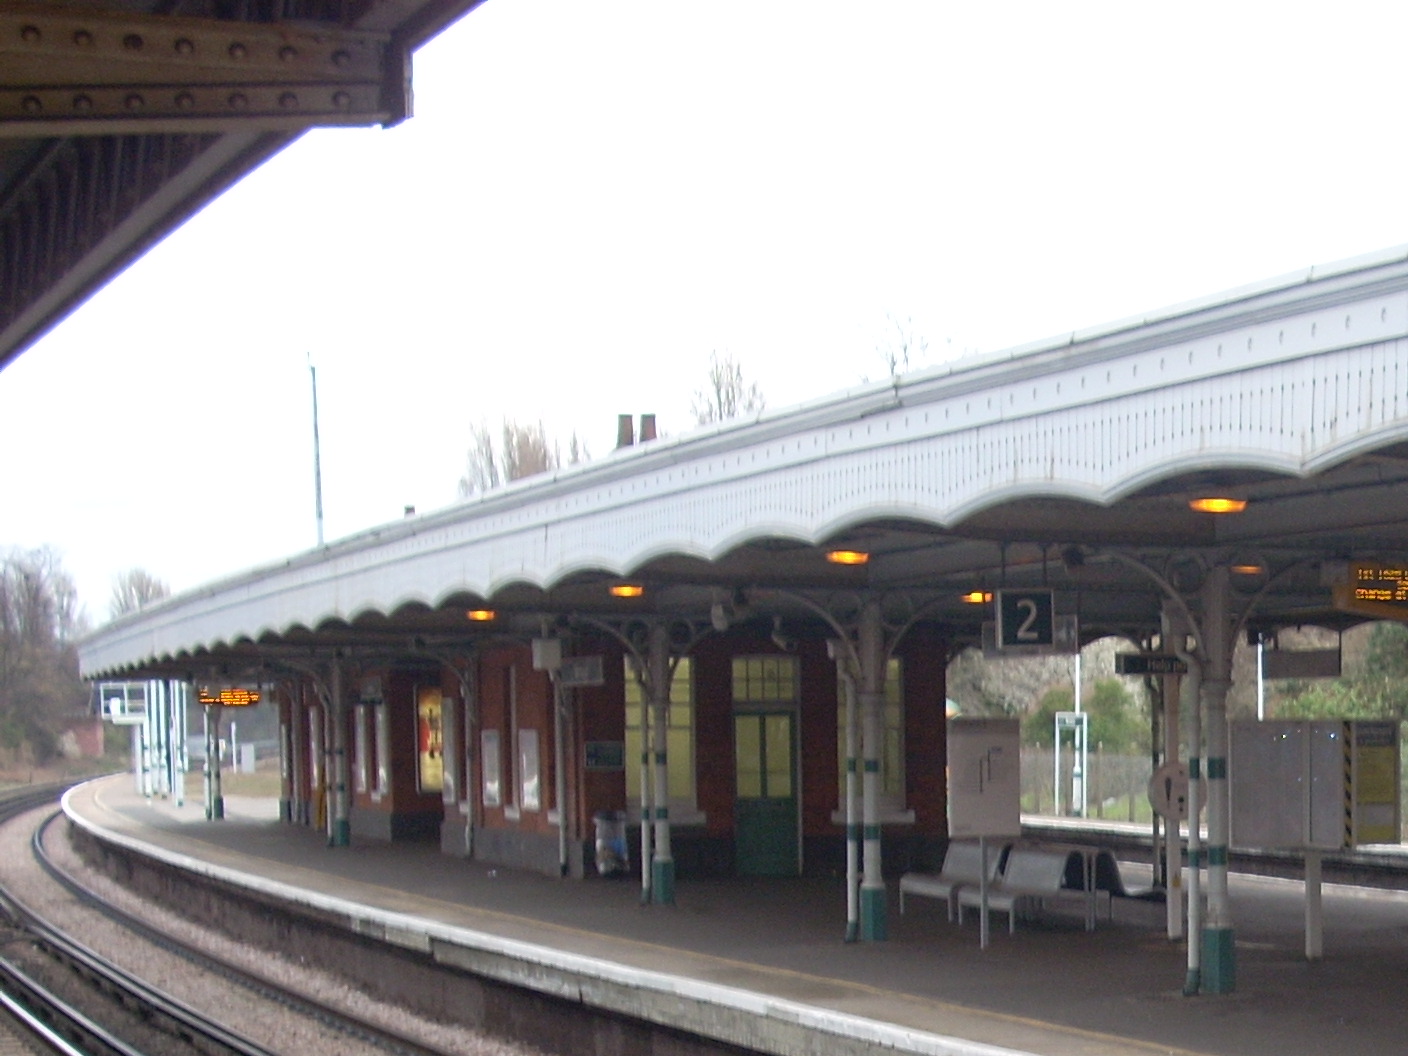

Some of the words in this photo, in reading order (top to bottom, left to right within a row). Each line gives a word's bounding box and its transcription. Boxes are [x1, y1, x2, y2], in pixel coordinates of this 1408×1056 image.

[1355, 588, 1392, 601] Change
[1395, 590, 1407, 601] at
[1016, 598, 1038, 640] 2
